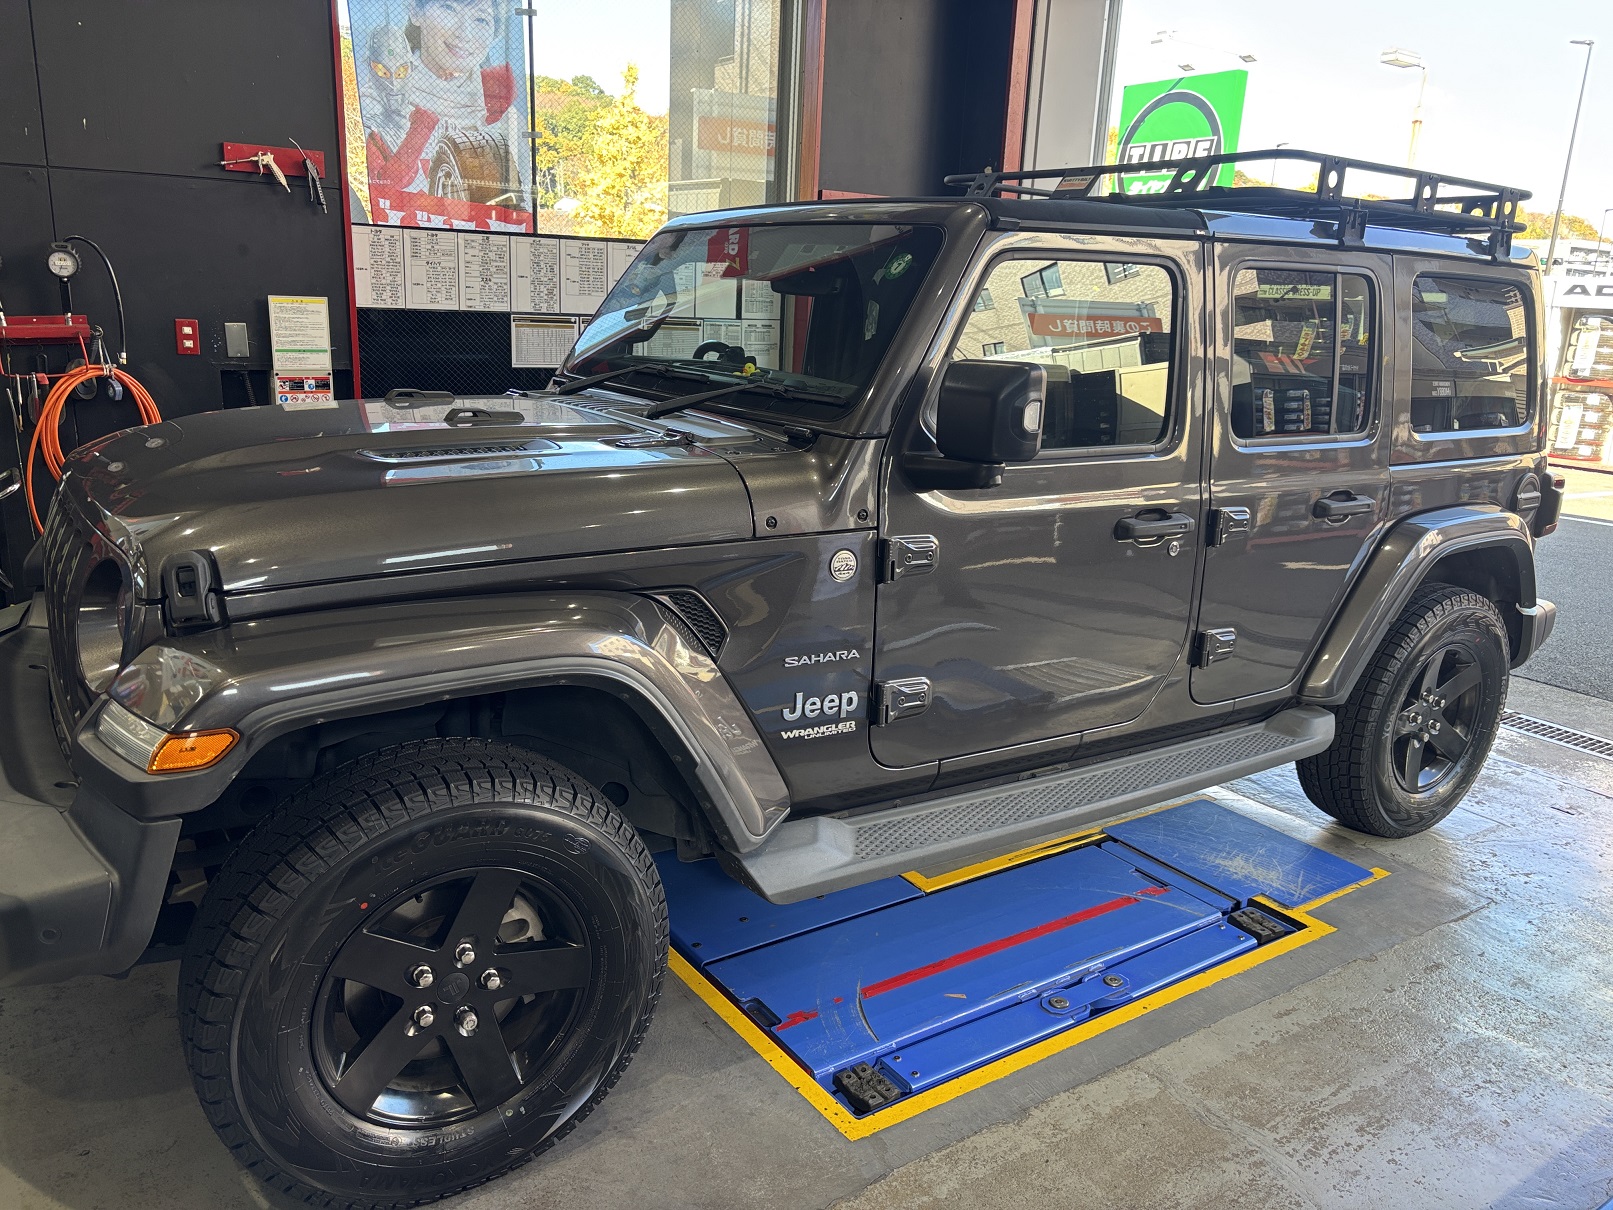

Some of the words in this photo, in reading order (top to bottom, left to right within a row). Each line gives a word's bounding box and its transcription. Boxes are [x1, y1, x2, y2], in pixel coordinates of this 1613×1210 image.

[784, 649, 860, 668] SAHARA
[782, 690, 859, 721] Jeep
[780, 720, 856, 740] WRANGLER
[804, 726, 856, 740] UNLIMITED
